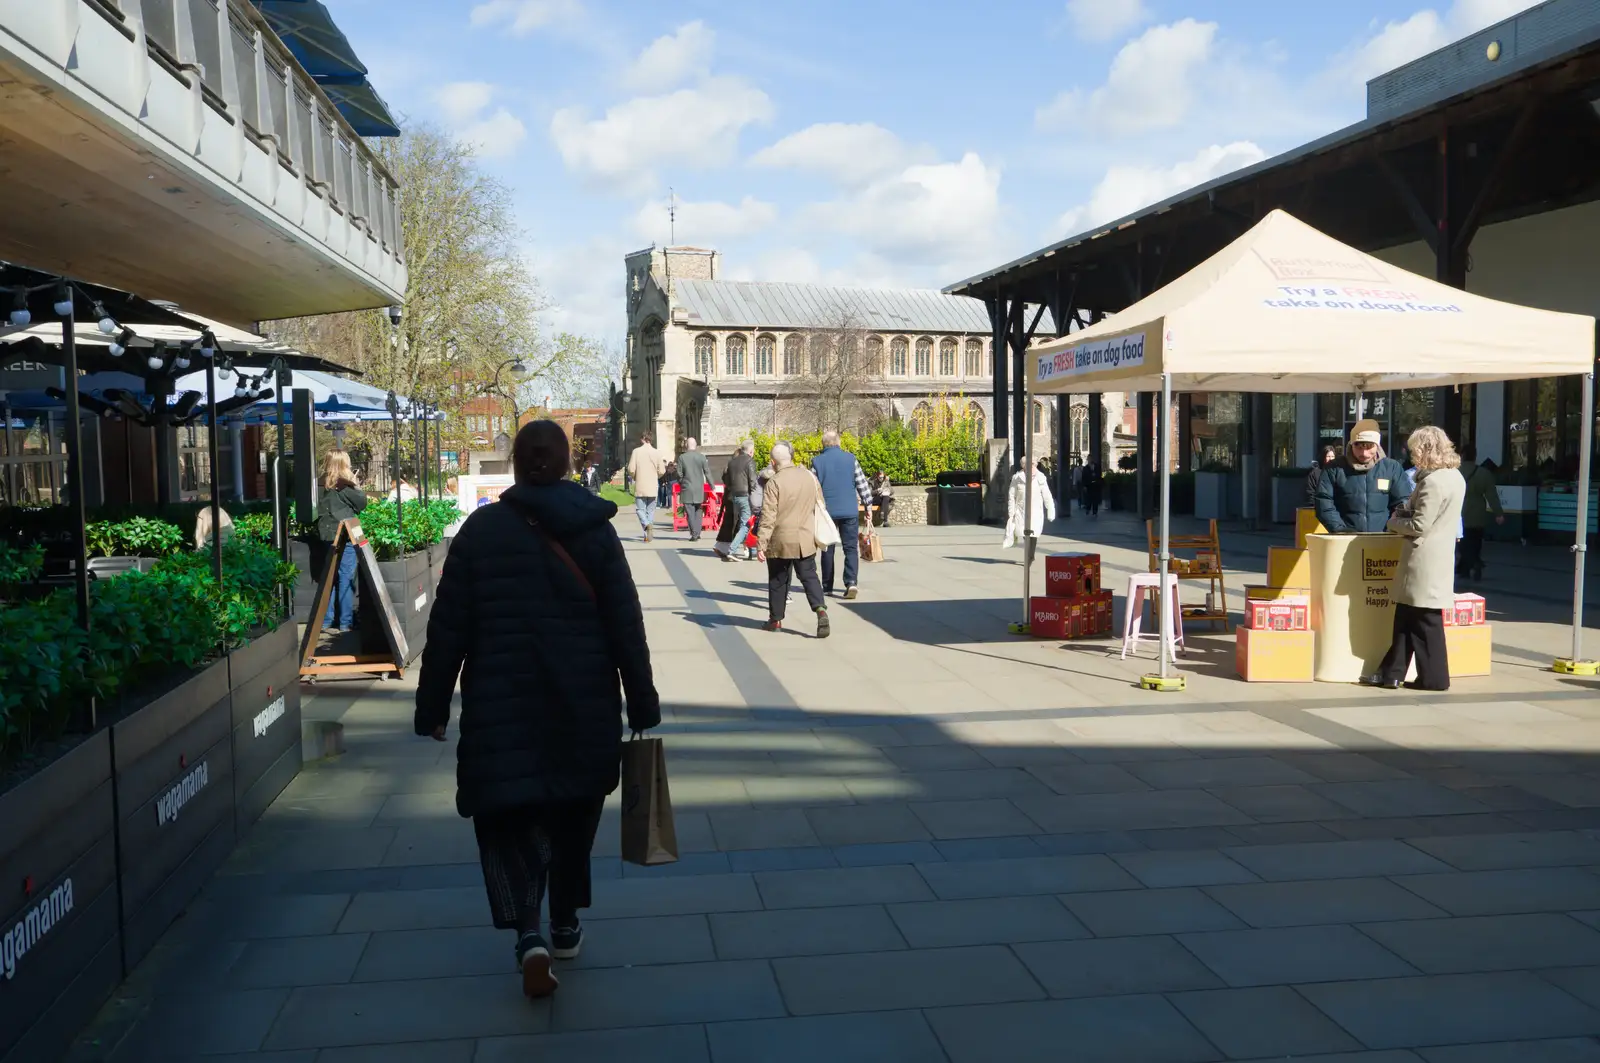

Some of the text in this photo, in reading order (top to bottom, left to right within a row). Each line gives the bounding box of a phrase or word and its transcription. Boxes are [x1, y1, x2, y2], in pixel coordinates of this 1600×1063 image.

[1277, 285, 1421, 301] Try a FRESH
[1264, 298, 1464, 314] take on dog food
[1038, 335, 1145, 380] Try a FRESH take on dog food
[1349, 398, 1369, 415] y!
[1049, 570, 1071, 582] MARRO
[1366, 567, 1387, 577] Box.
[1367, 586, 1389, 595] Fresh
[1366, 596, 1389, 607] Happy
[1034, 611, 1059, 623] MARRO
[156, 760, 208, 826] wagamama
